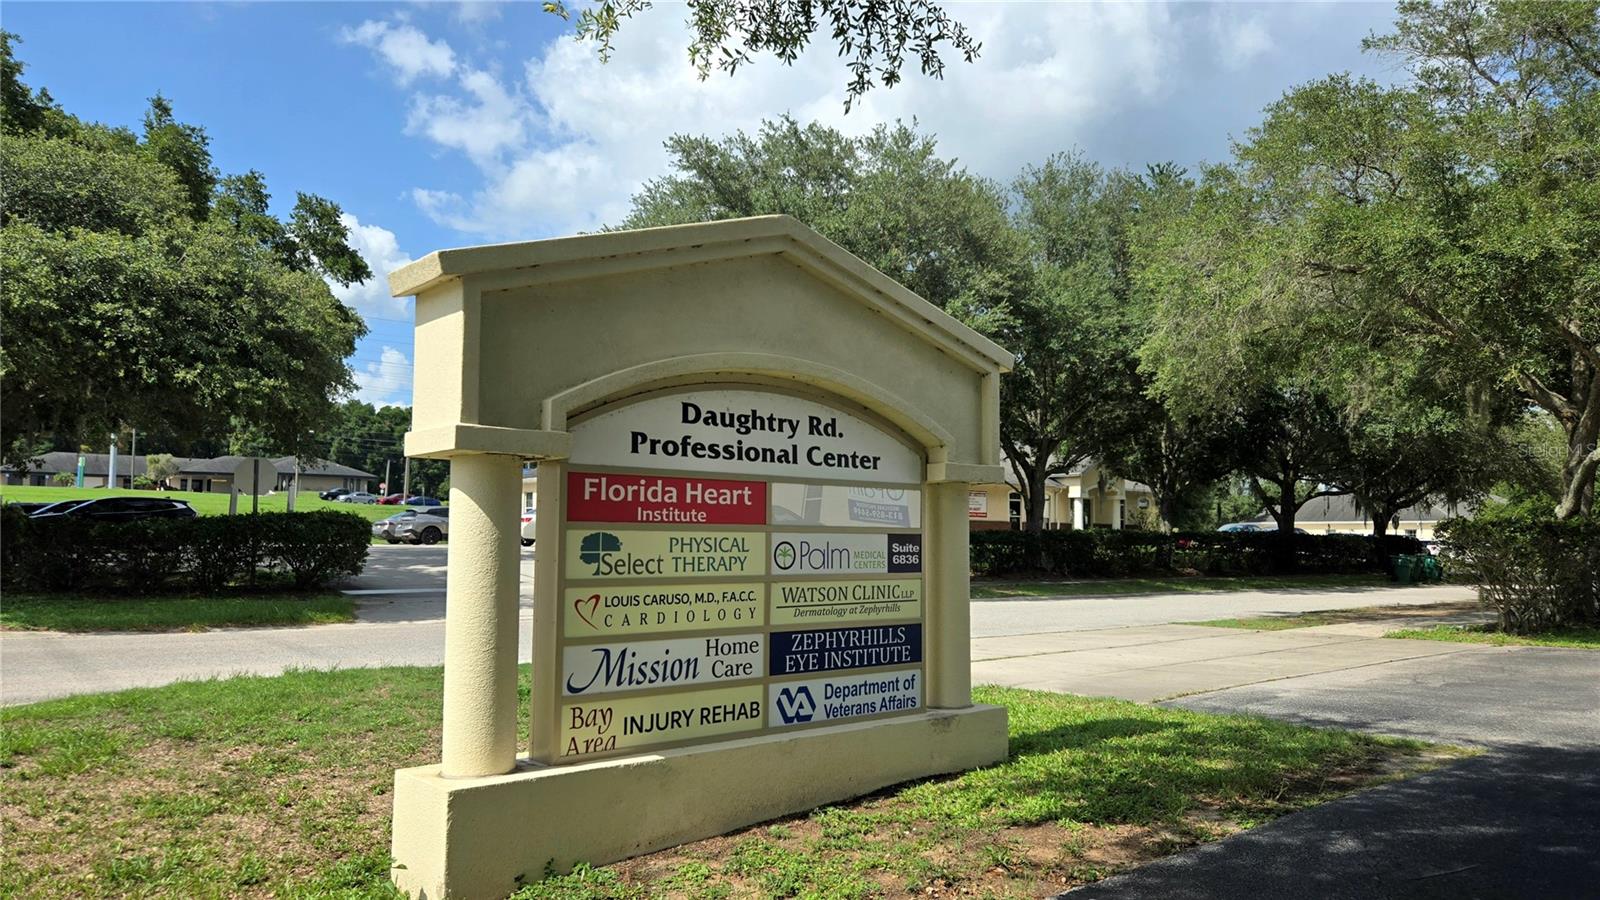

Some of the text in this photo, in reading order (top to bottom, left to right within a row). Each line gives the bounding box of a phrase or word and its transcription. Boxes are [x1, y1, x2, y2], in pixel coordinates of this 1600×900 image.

[681, 402, 844, 439] Daughtry Rd.
[631, 431, 881, 470] Professional Center
[584, 477, 752, 505] Florida Heart
[637, 507, 707, 523] Institute
[669, 537, 749, 553] PHYSICAL
[892, 543, 920, 553] Suite
[600, 553, 664, 576] Select
[672, 556, 747, 573] THERAPY
[800, 541, 850, 570] Palm
[854, 551, 886, 560] MEDICAL
[854, 560, 886, 569] CENTERS
[892, 554, 920, 565] 6836
[604, 591, 756, 608] LOUIS CARUSO, M.D., F.A.C.C.
[782, 584, 914, 603] WATSON CLINIC LLP
[604, 607, 756, 627] CARDIOLOGY
[793, 604, 901, 618] Dermatology at Zephyrhills
[705, 639, 759, 657] Home
[791, 627, 906, 651] ZEPHYRHILLS
[785, 645, 911, 672] EYE INSTITUTE
[566, 647, 700, 694] Mission
[712, 660, 753, 678] Care
[824, 674, 916, 702] Department of
[824, 694, 916, 719] Veterans Affairs
[569, 706, 613, 734] Bay
[623, 701, 761, 736] INJURY REHAB
[566, 735, 616, 756] Area
